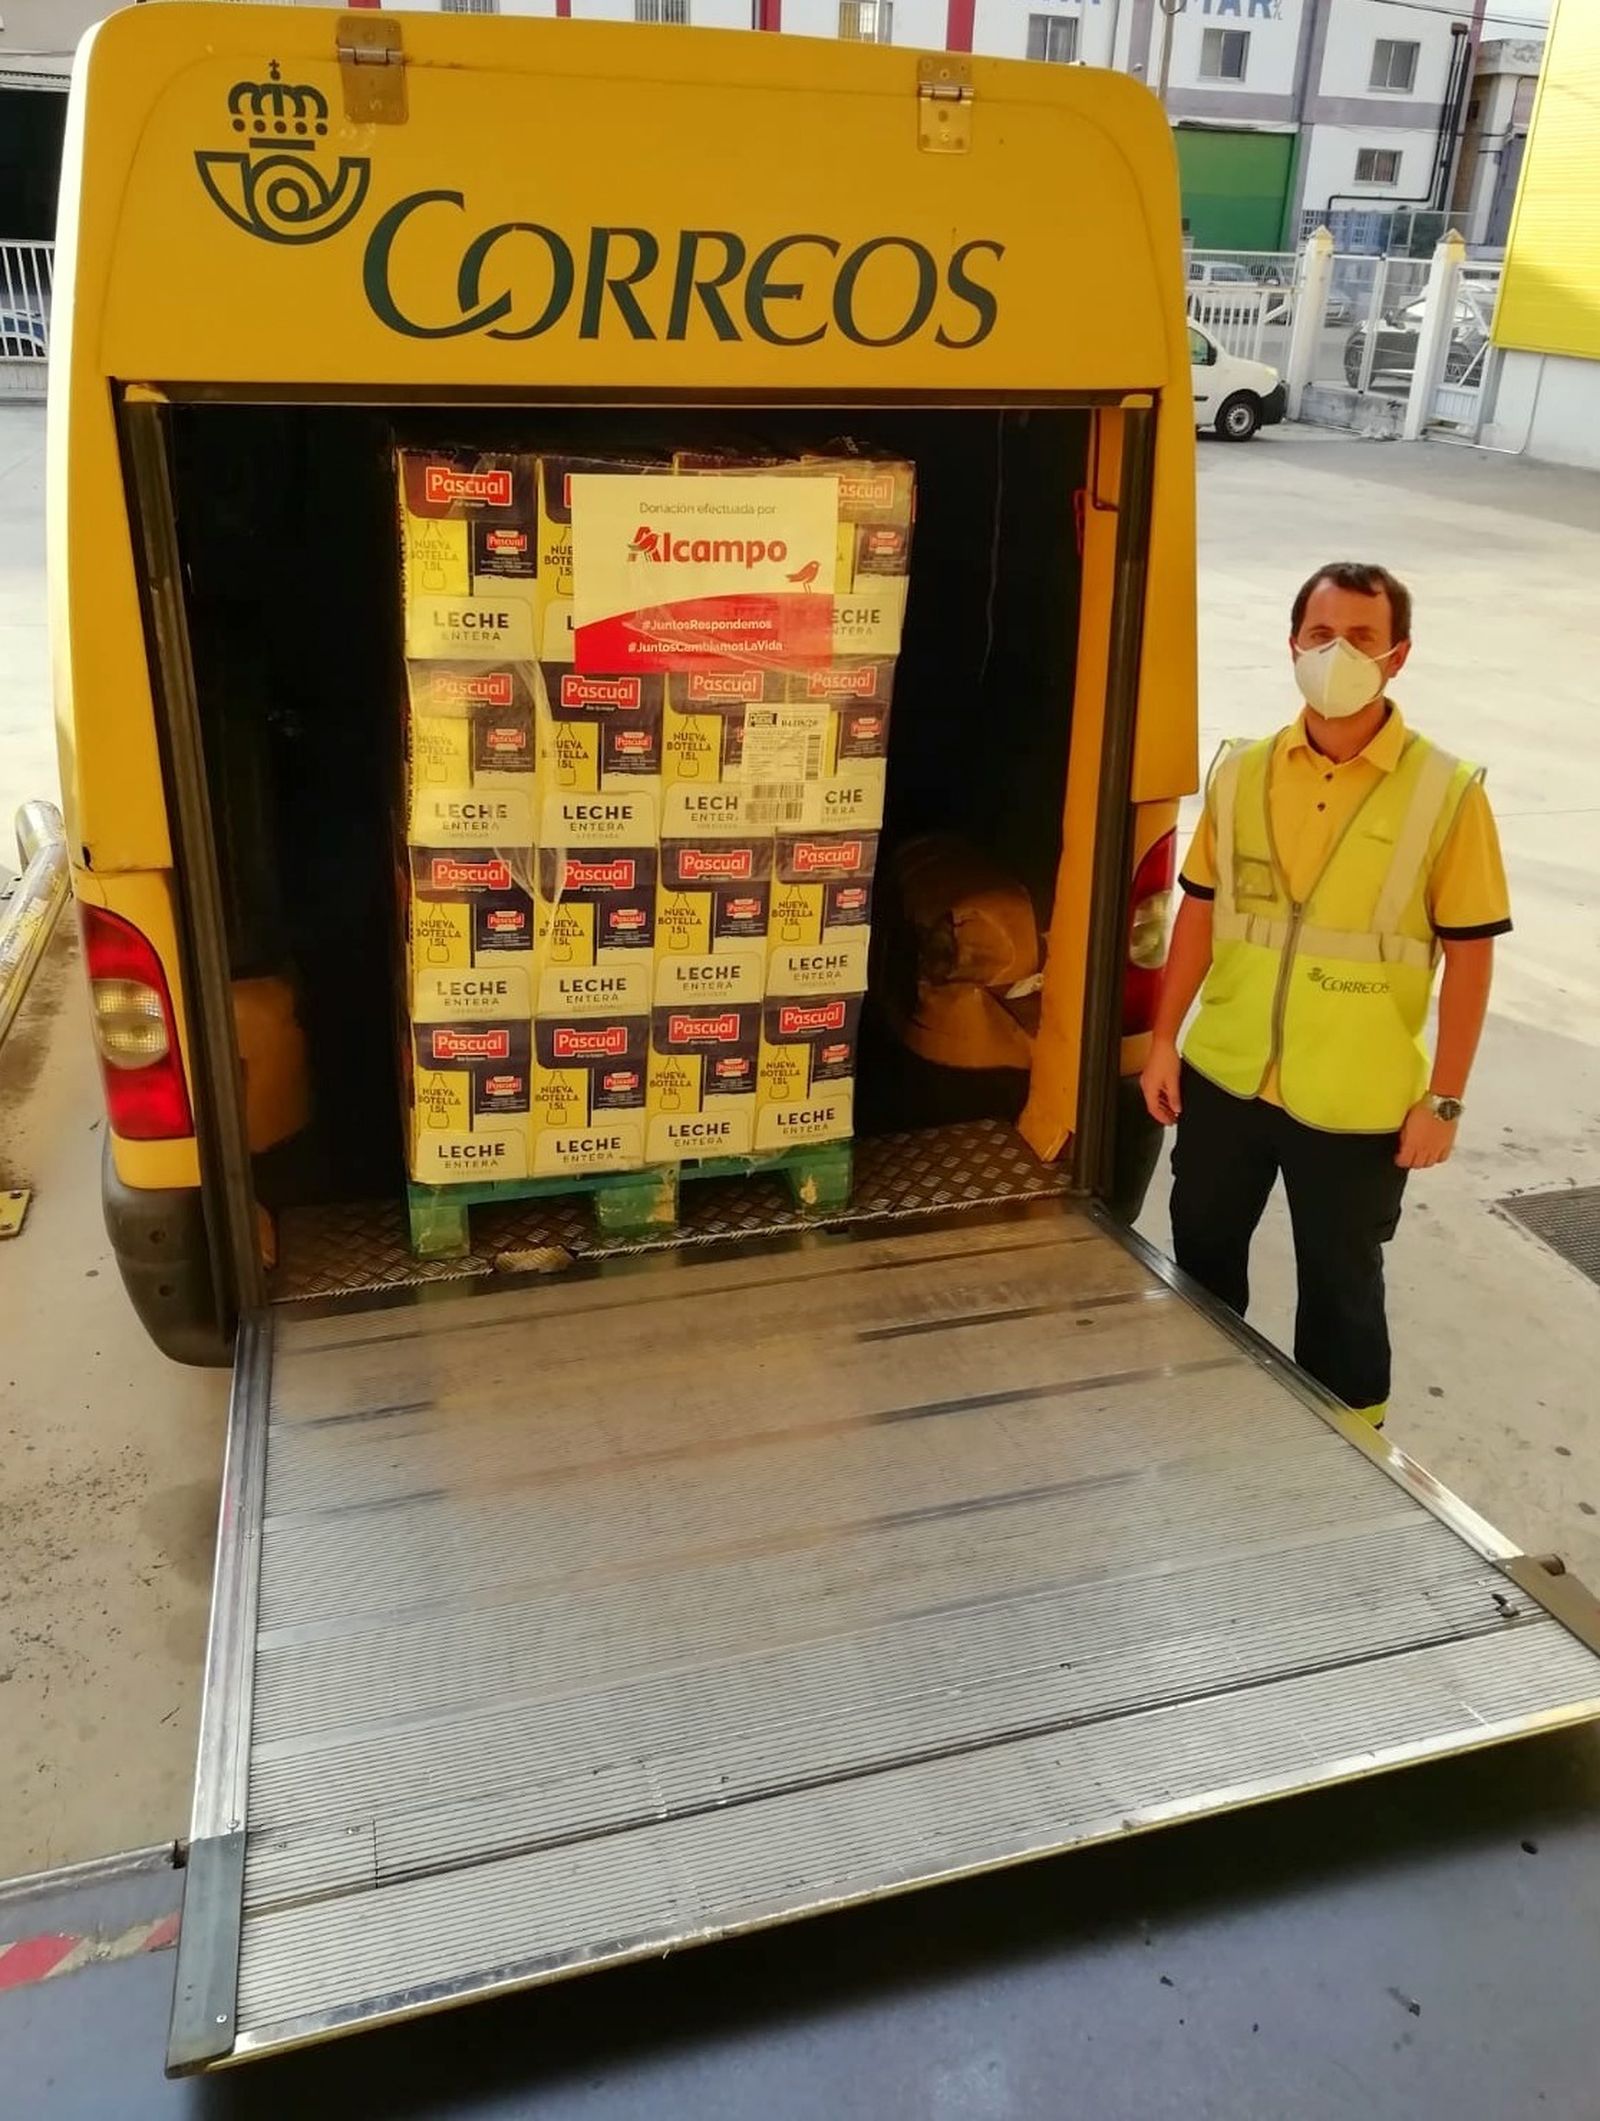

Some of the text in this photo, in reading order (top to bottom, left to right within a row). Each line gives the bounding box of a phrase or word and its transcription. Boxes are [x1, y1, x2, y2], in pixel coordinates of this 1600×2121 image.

[363, 190, 1006, 349] CORREOS
[431, 473, 504, 495] Pascual
[839, 484, 888, 499] ascual
[697, 503, 755, 514] efectuada
[756, 506, 777, 518] por
[551, 545, 573, 555] NUE
[627, 526, 787, 569] Alcampo
[544, 556, 573, 566] BOTE
[434, 611, 509, 628] LECHE
[831, 609, 880, 624] ECHE
[642, 619, 772, 633] #JuntosRespondemos
[442, 631, 501, 641] ENTERA
[628, 640, 783, 653] #JuntosCambiamosLaVida
[436, 677, 505, 695] Pascual
[693, 675, 757, 693] Pascual
[812, 672, 871, 689] Pascual
[566, 681, 633, 700] Pascual
[557, 739, 583, 749] UEVA
[673, 732, 707, 741] NUEVA
[667, 741, 711, 751] BOTELLA
[685, 796, 739, 811] LECH
[825, 789, 864, 804] CHE
[435, 803, 508, 819] LECHE
[563, 805, 633, 820] LECHE
[442, 822, 499, 831] ENTERA
[570, 822, 625, 832] ENTERA
[684, 855, 745, 871] Pascual
[798, 848, 855, 864] Pascual
[437, 864, 504, 881] Pascual
[565, 865, 628, 881] Pascual
[664, 908, 696, 917] NUEVA
[778, 901, 809, 910] NUEVA
[421, 920, 455, 929] NUEVA
[658, 917, 702, 925] BOTELLA
[539, 928, 584, 937] BTELLA
[788, 955, 848, 971] LECHE
[676, 966, 741, 981] LECHE
[794, 971, 842, 981] ENTERA
[437, 981, 507, 996] LECHE
[560, 977, 627, 993] LECHE
[682, 982, 733, 991] ENTERA
[1321, 976, 1390, 994] CORREOS
[444, 998, 500, 1007] ENTERA
[566, 994, 619, 1004] ENTERA
[784, 1008, 839, 1025] Pascual
[674, 1018, 733, 1034] Pascual
[438, 1036, 502, 1051] Pascual
[559, 1032, 620, 1048] Pascual
[766, 1061, 796, 1069] NUEVA
[655, 1071, 687, 1079] NUEVA
[423, 1088, 454, 1097] NUEVA
[540, 1085, 573, 1094] NUEVA
[777, 1108, 836, 1126] LECHE
[668, 1122, 731, 1137] LECHE
[783, 1123, 829, 1134] ENTERA
[556, 1137, 621, 1153] LECHE
[674, 1137, 723, 1147] ENTERA
[438, 1143, 505, 1158] LECHE
[445, 1160, 498, 1169] ENTERA
[563, 1153, 613, 1164] ENTERA
